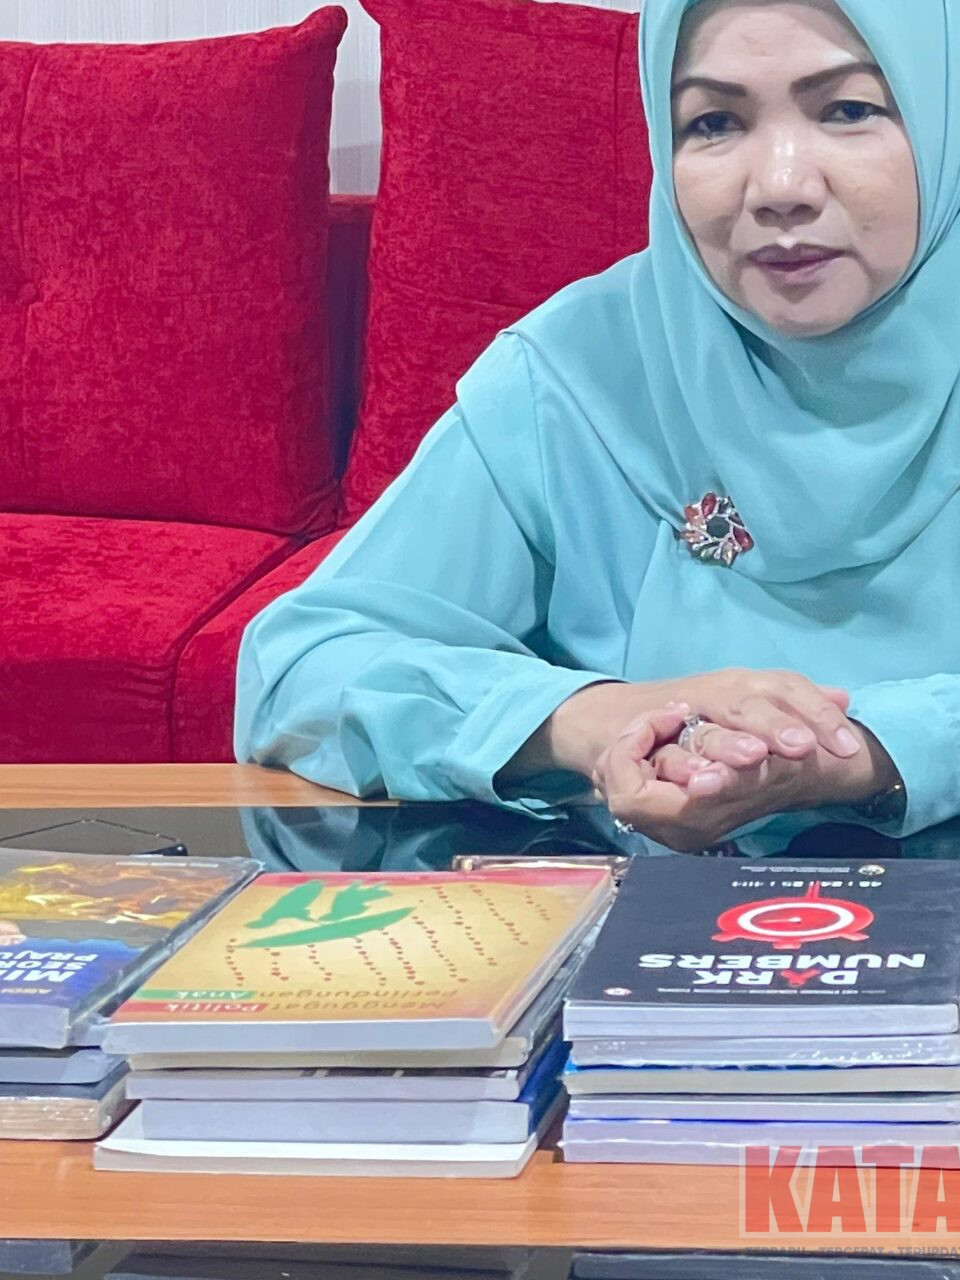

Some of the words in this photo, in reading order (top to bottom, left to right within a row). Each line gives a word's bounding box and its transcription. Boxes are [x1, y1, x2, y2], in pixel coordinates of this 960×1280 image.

[638, 952, 927, 969] NUMBERS
[173, 990, 249, 1000] Anak
[259, 989, 458, 1001] Perlindungan
[164, 1002, 260, 1013] Politik
[271, 1000, 446, 1011] Menggugat
